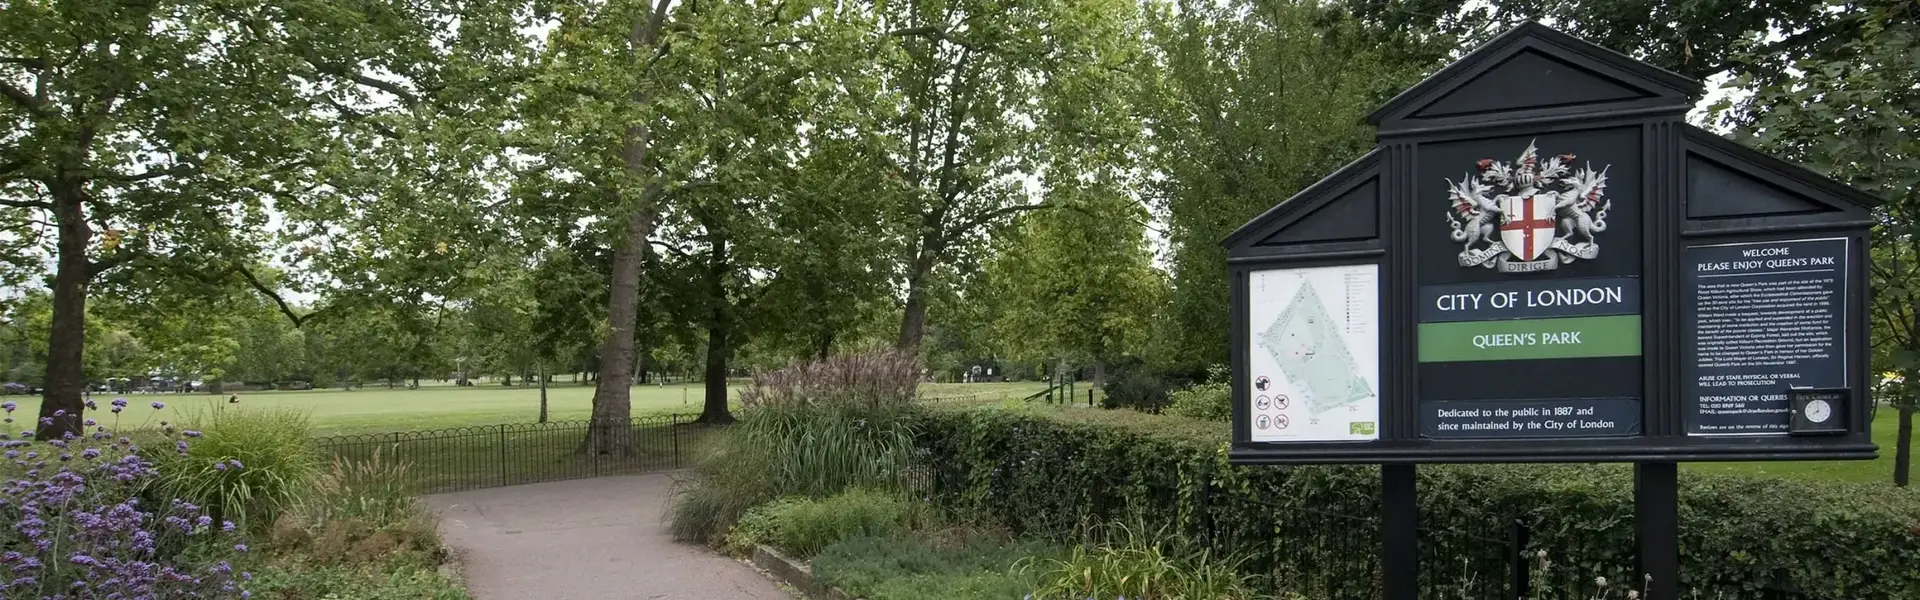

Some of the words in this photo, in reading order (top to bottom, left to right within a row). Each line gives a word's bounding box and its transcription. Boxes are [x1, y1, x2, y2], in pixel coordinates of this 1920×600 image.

[1742, 248, 1790, 257] WELCOME
[1508, 262, 1548, 271] DIRIGE
[1698, 262, 1730, 271] PLEASE
[1733, 260, 1763, 270] ENJOY
[1766, 258, 1807, 268] QUEEN'S
[1810, 257, 1834, 265] PARK
[1436, 294, 1482, 310] CITY
[1490, 292, 1518, 308] OF
[1528, 287, 1622, 307] LONDON
[1473, 333, 1536, 348] QUEEN'S
[1542, 332, 1581, 344] PARK
[1438, 408, 1479, 417] Dedicated
[1495, 408, 1508, 417] the
[1512, 408, 1539, 418] public
[1554, 407, 1573, 416] 1887
[1576, 407, 1593, 415] and
[1438, 422, 1459, 431] since
[1462, 421, 1509, 430] maintained
[1513, 421, 1524, 431] by
[1527, 421, 1541, 429] the
[1544, 420, 1563, 430] City
[1567, 420, 1577, 429] of
[1580, 420, 1614, 429] London
